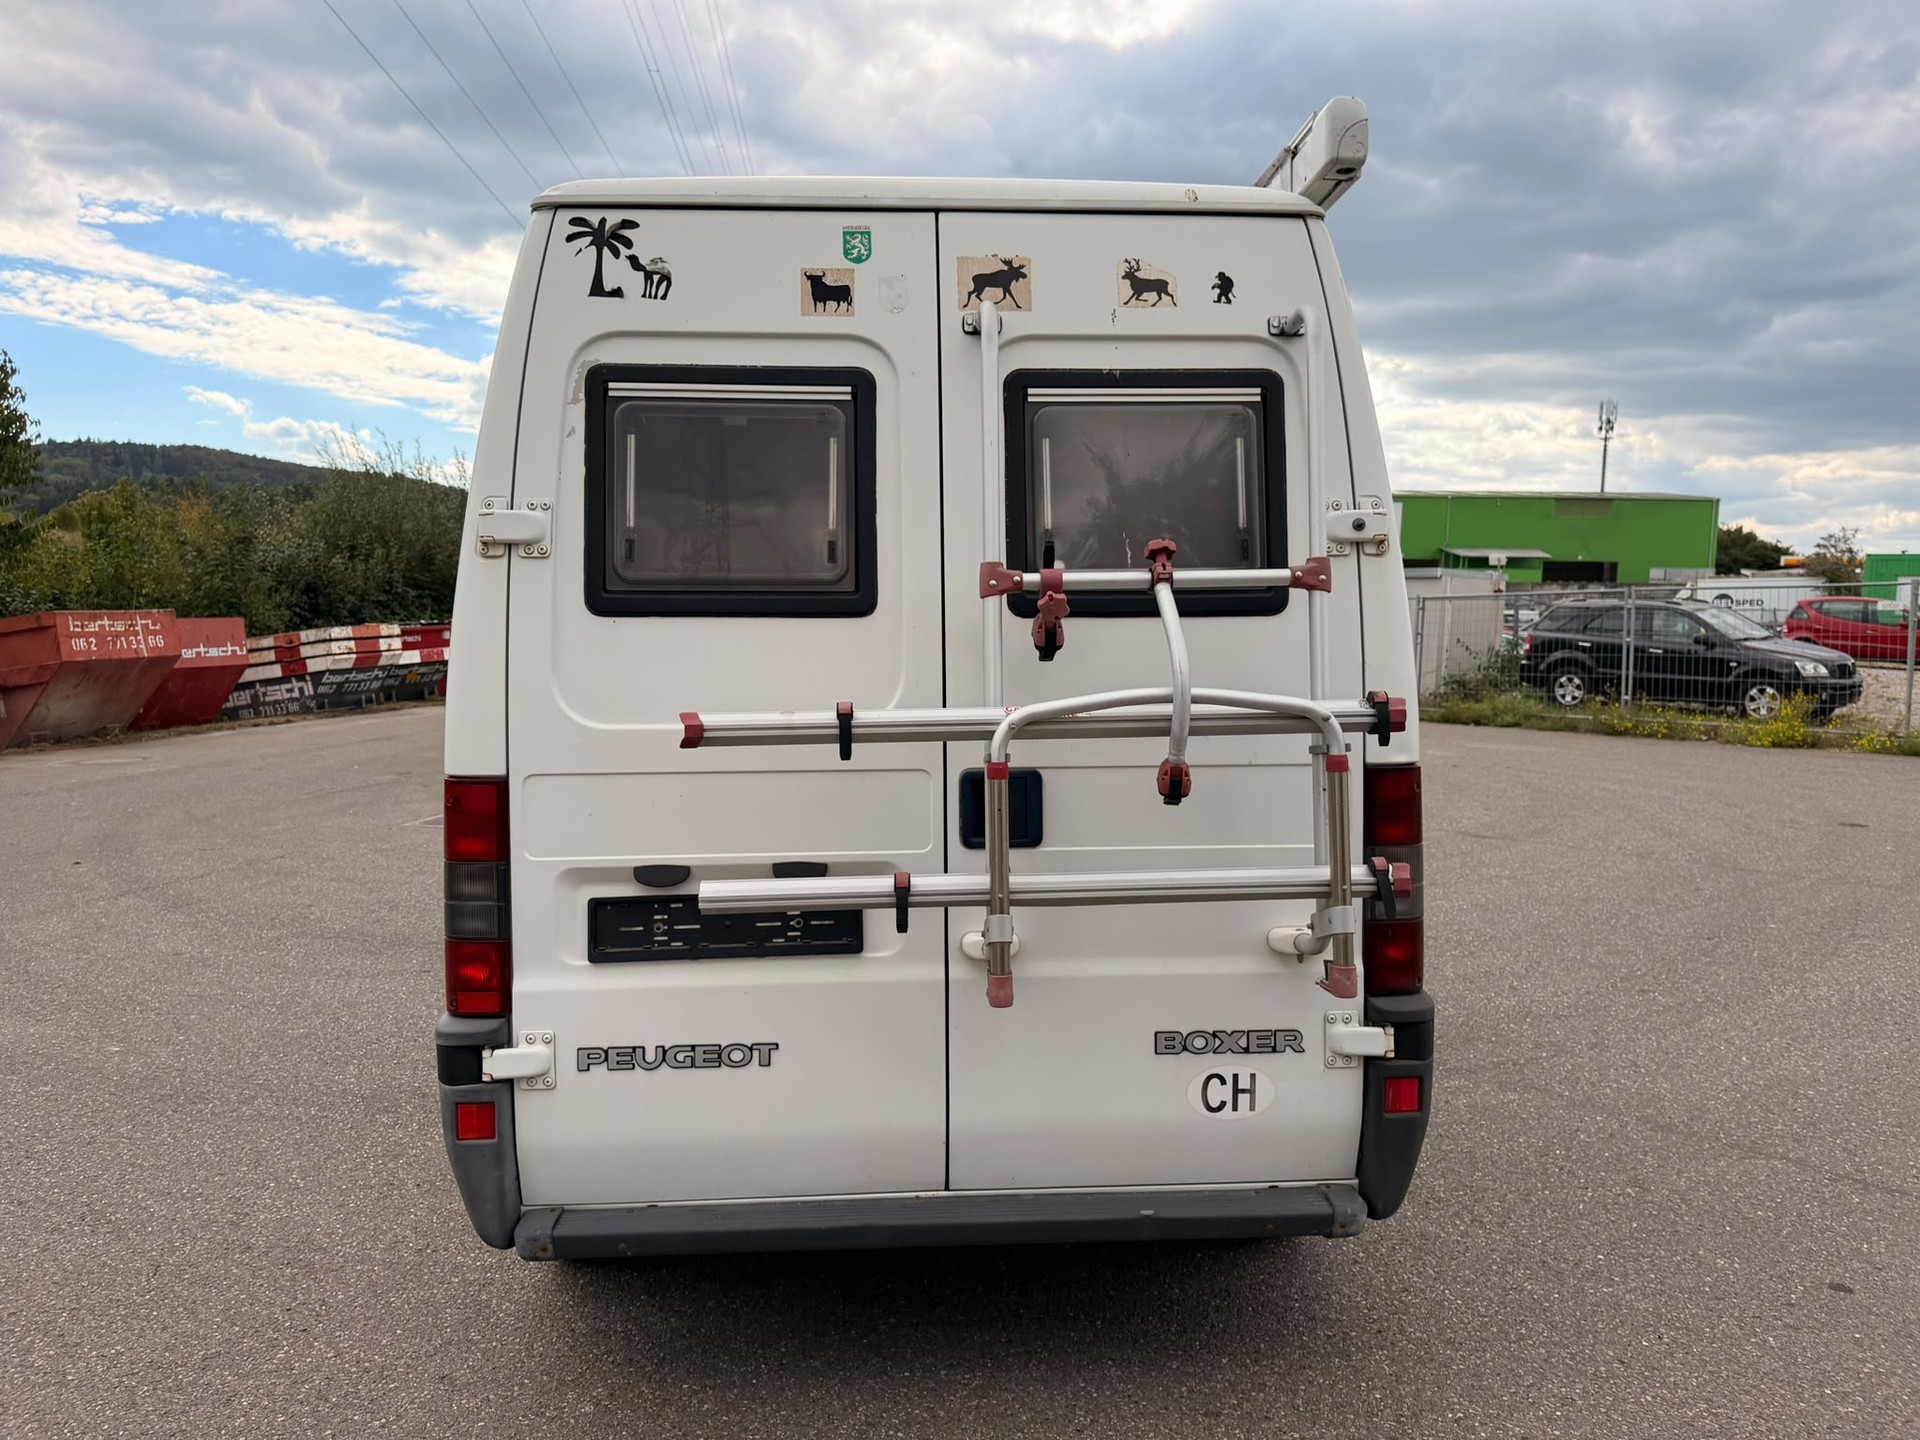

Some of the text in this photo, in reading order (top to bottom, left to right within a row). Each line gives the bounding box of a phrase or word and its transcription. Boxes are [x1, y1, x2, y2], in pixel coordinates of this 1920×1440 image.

[1735, 599, 1764, 608] SPED
[71, 637, 97, 651] 062
[148, 634, 164, 648] 66
[182, 640, 246, 659] ertschi
[1155, 1029, 1305, 1055] BOXER
[577, 1043, 779, 1071] PEUGEOT
[1201, 1073, 1257, 1113] CH
